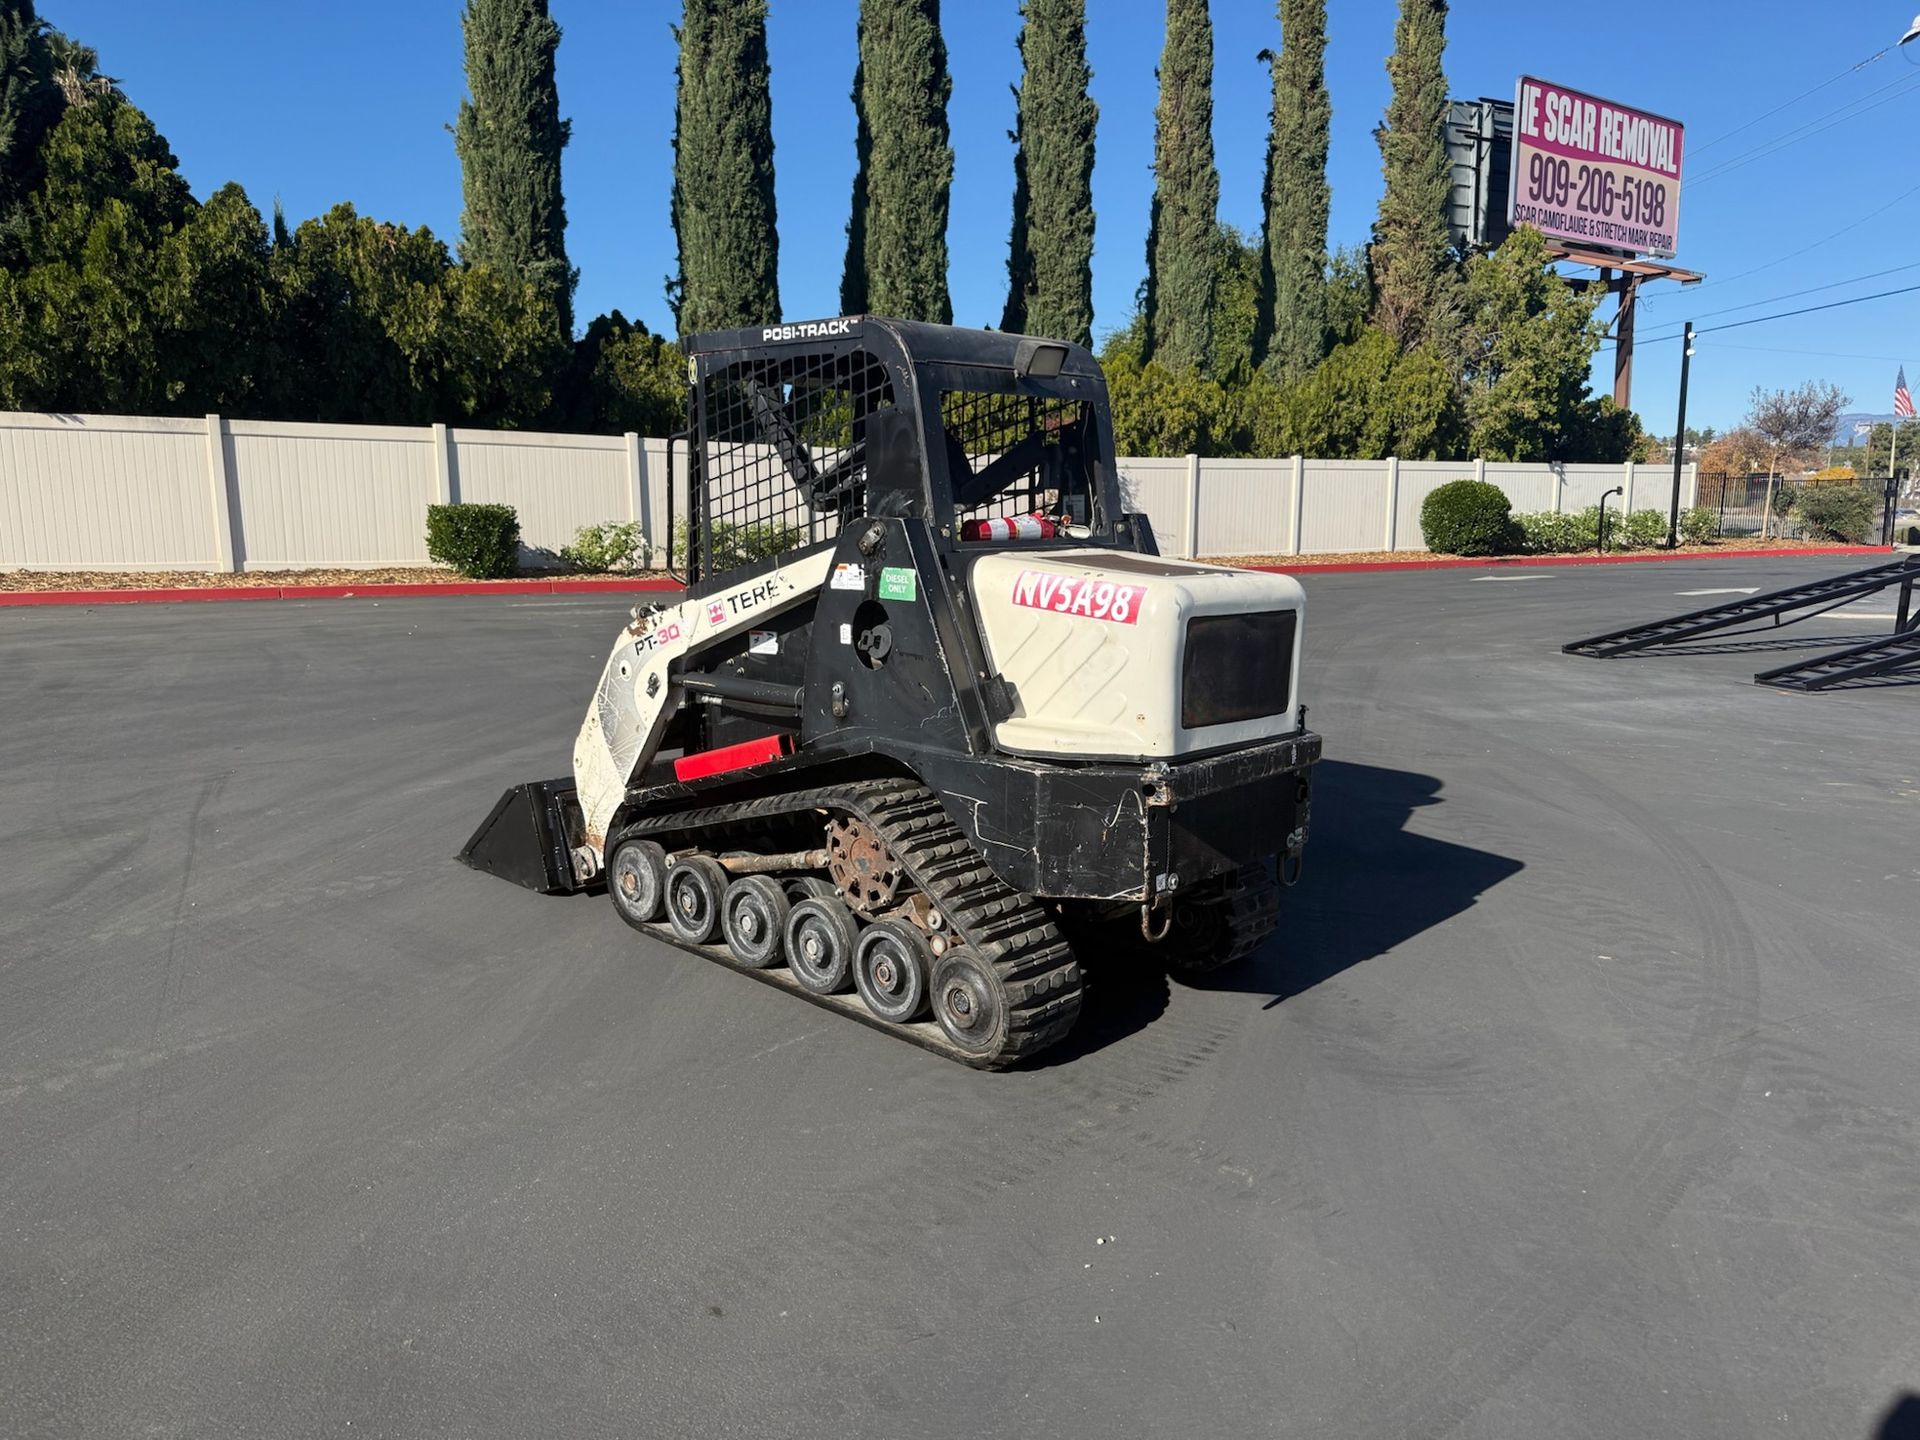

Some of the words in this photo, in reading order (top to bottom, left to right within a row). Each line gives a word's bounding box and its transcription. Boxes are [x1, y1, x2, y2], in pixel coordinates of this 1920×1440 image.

[1521, 84, 1542, 137] IE
[1544, 91, 1596, 152] SCAR
[1600, 107, 1677, 173] REMOVAL
[1529, 152, 1666, 228] 909-206-5198
[1515, 204, 1537, 224] SCAR
[1589, 220, 1595, 236] &
[1595, 221, 1627, 242] STRETCH
[1628, 227, 1648, 246] MARK
[1649, 231, 1673, 250] REPAIR
[727, 575, 795, 614] TERE
[886, 574, 909, 584] DIESEL
[888, 585, 907, 593] ONLY
[1015, 571, 1135, 621] NV5A98
[635, 624, 680, 656] PT-30
